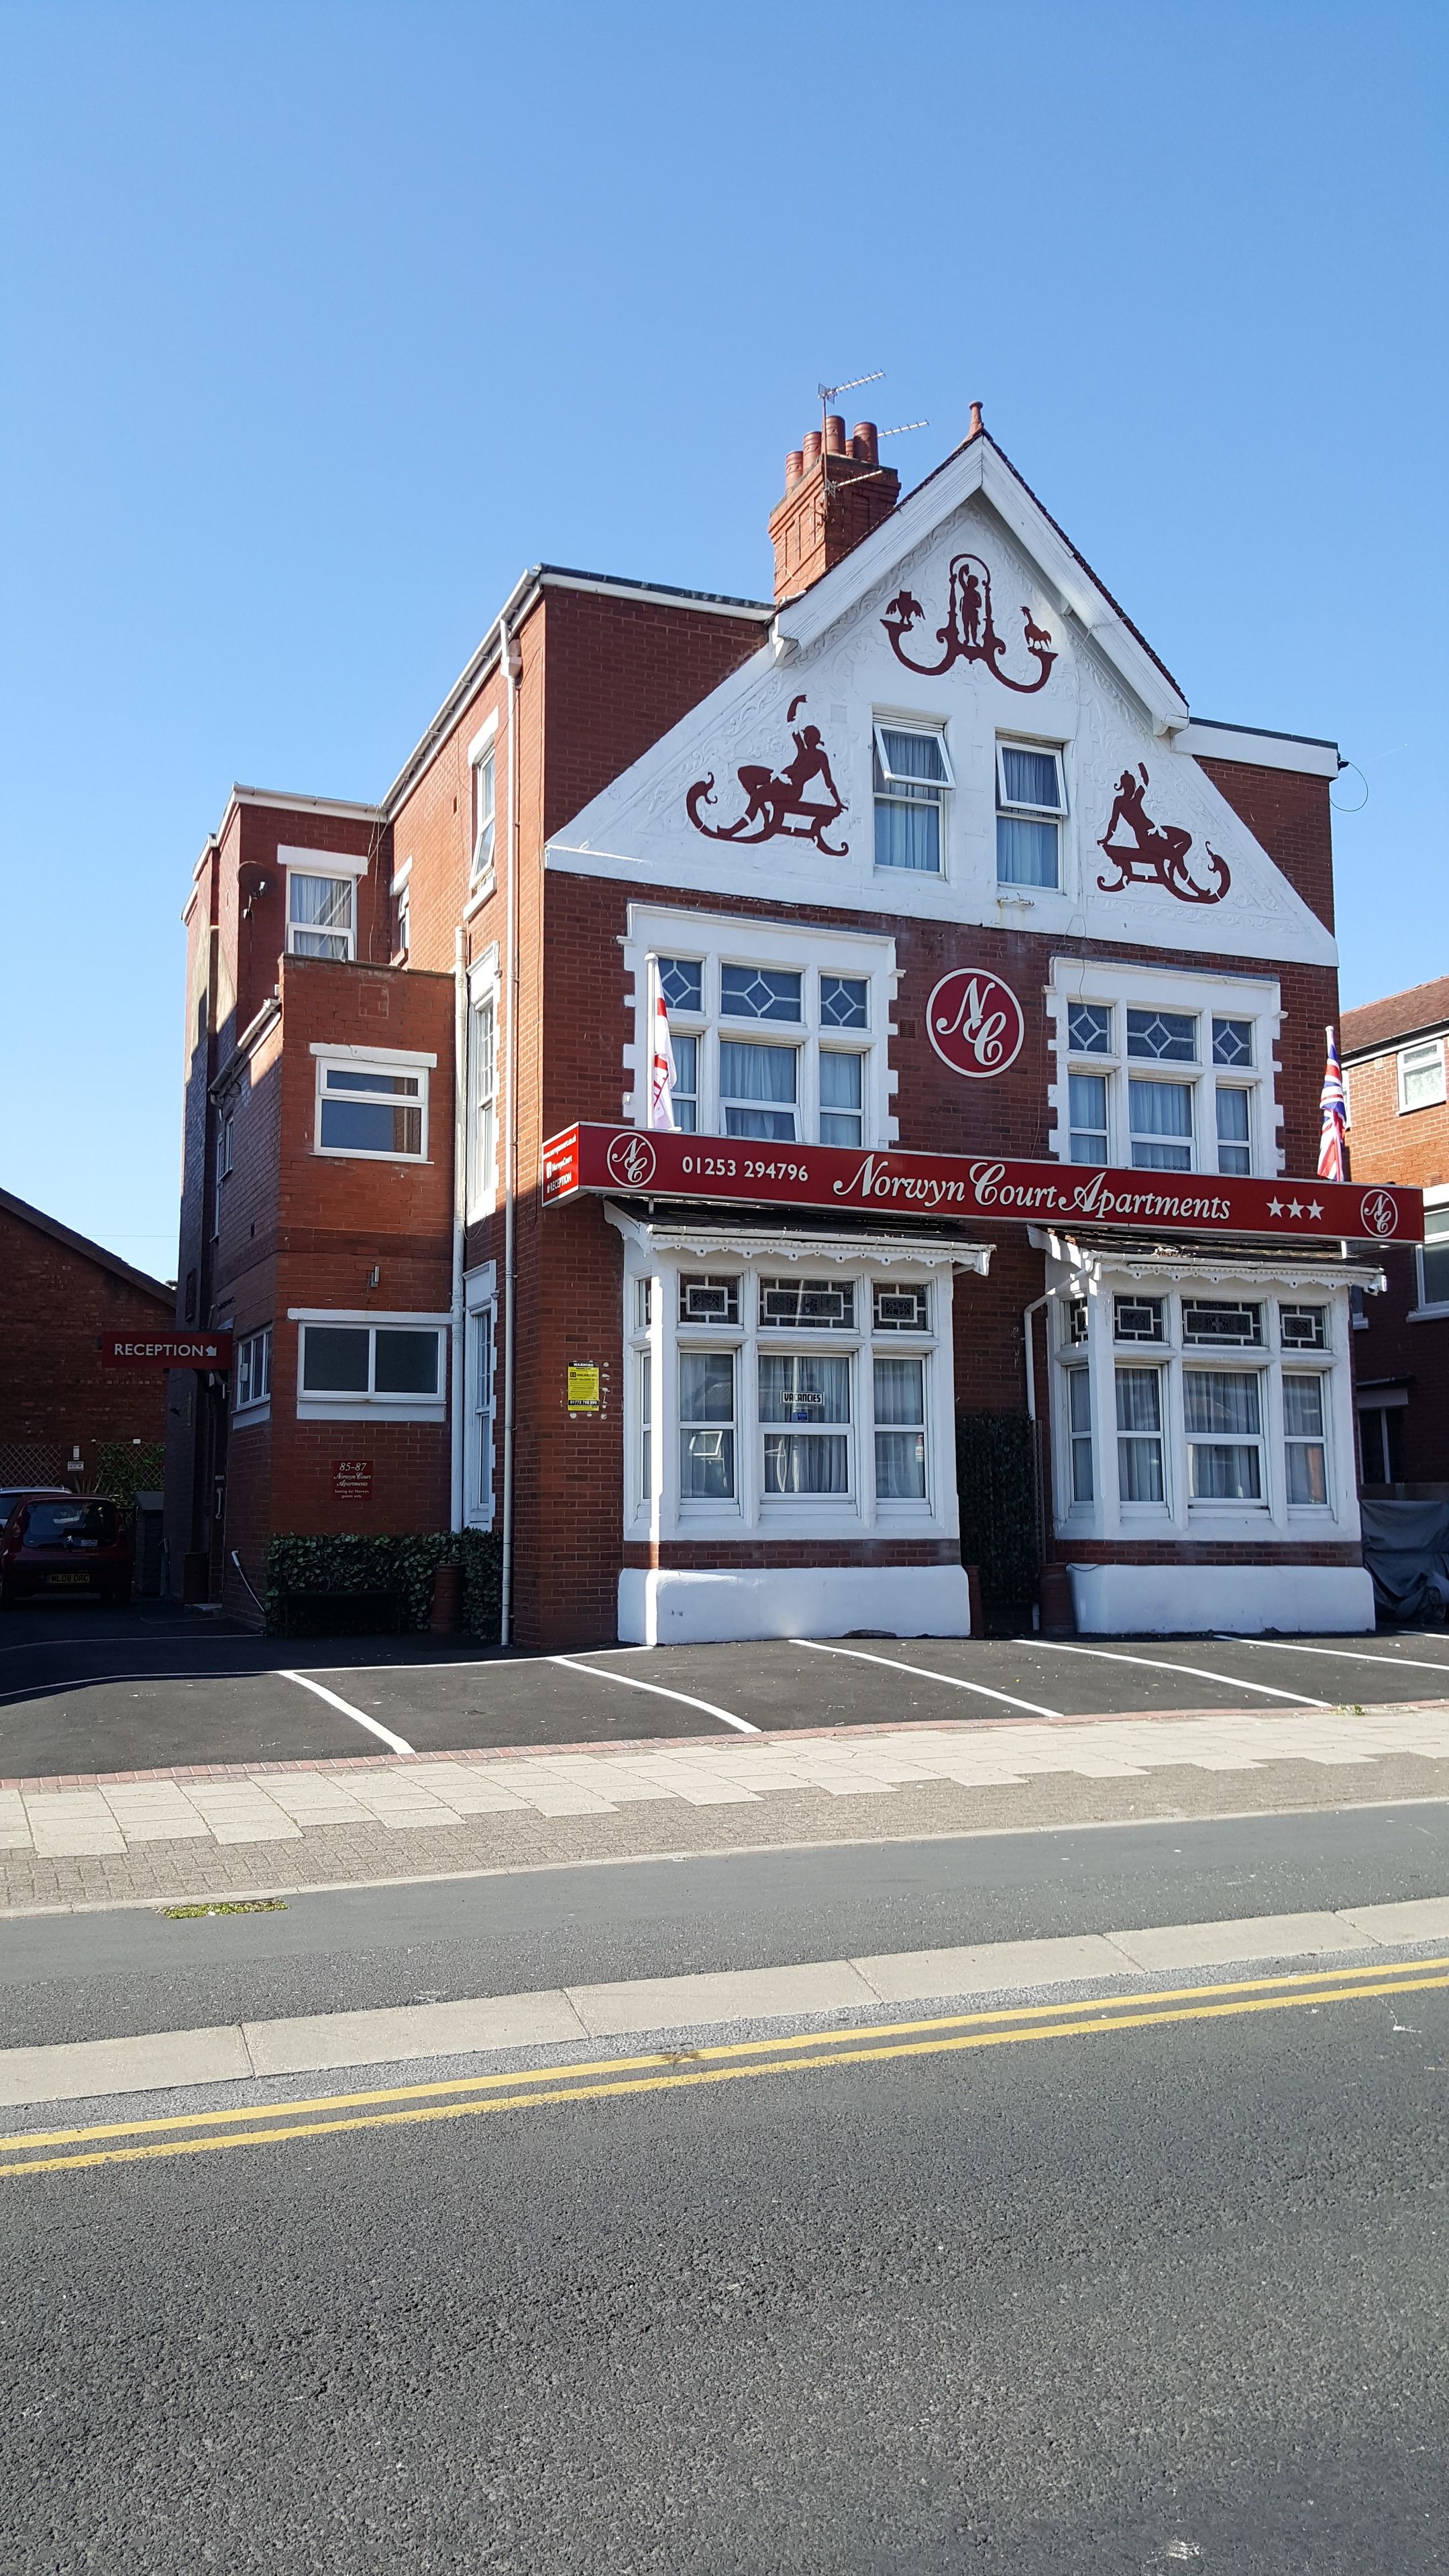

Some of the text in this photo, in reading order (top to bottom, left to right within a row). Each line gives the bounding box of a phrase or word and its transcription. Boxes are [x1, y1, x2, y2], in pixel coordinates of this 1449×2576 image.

[682, 1156, 808, 1181] 01253 294796
[549, 1171, 572, 1192] RECEPTION
[833, 1154, 1231, 1219] Norwyn Court Apartments
[114, 1344, 203, 1356] RECEPTION
[339, 1462, 367, 1471] 85-87
[356, 1472, 372, 1480] Court
[337, 1479, 368, 1487] Apartments
